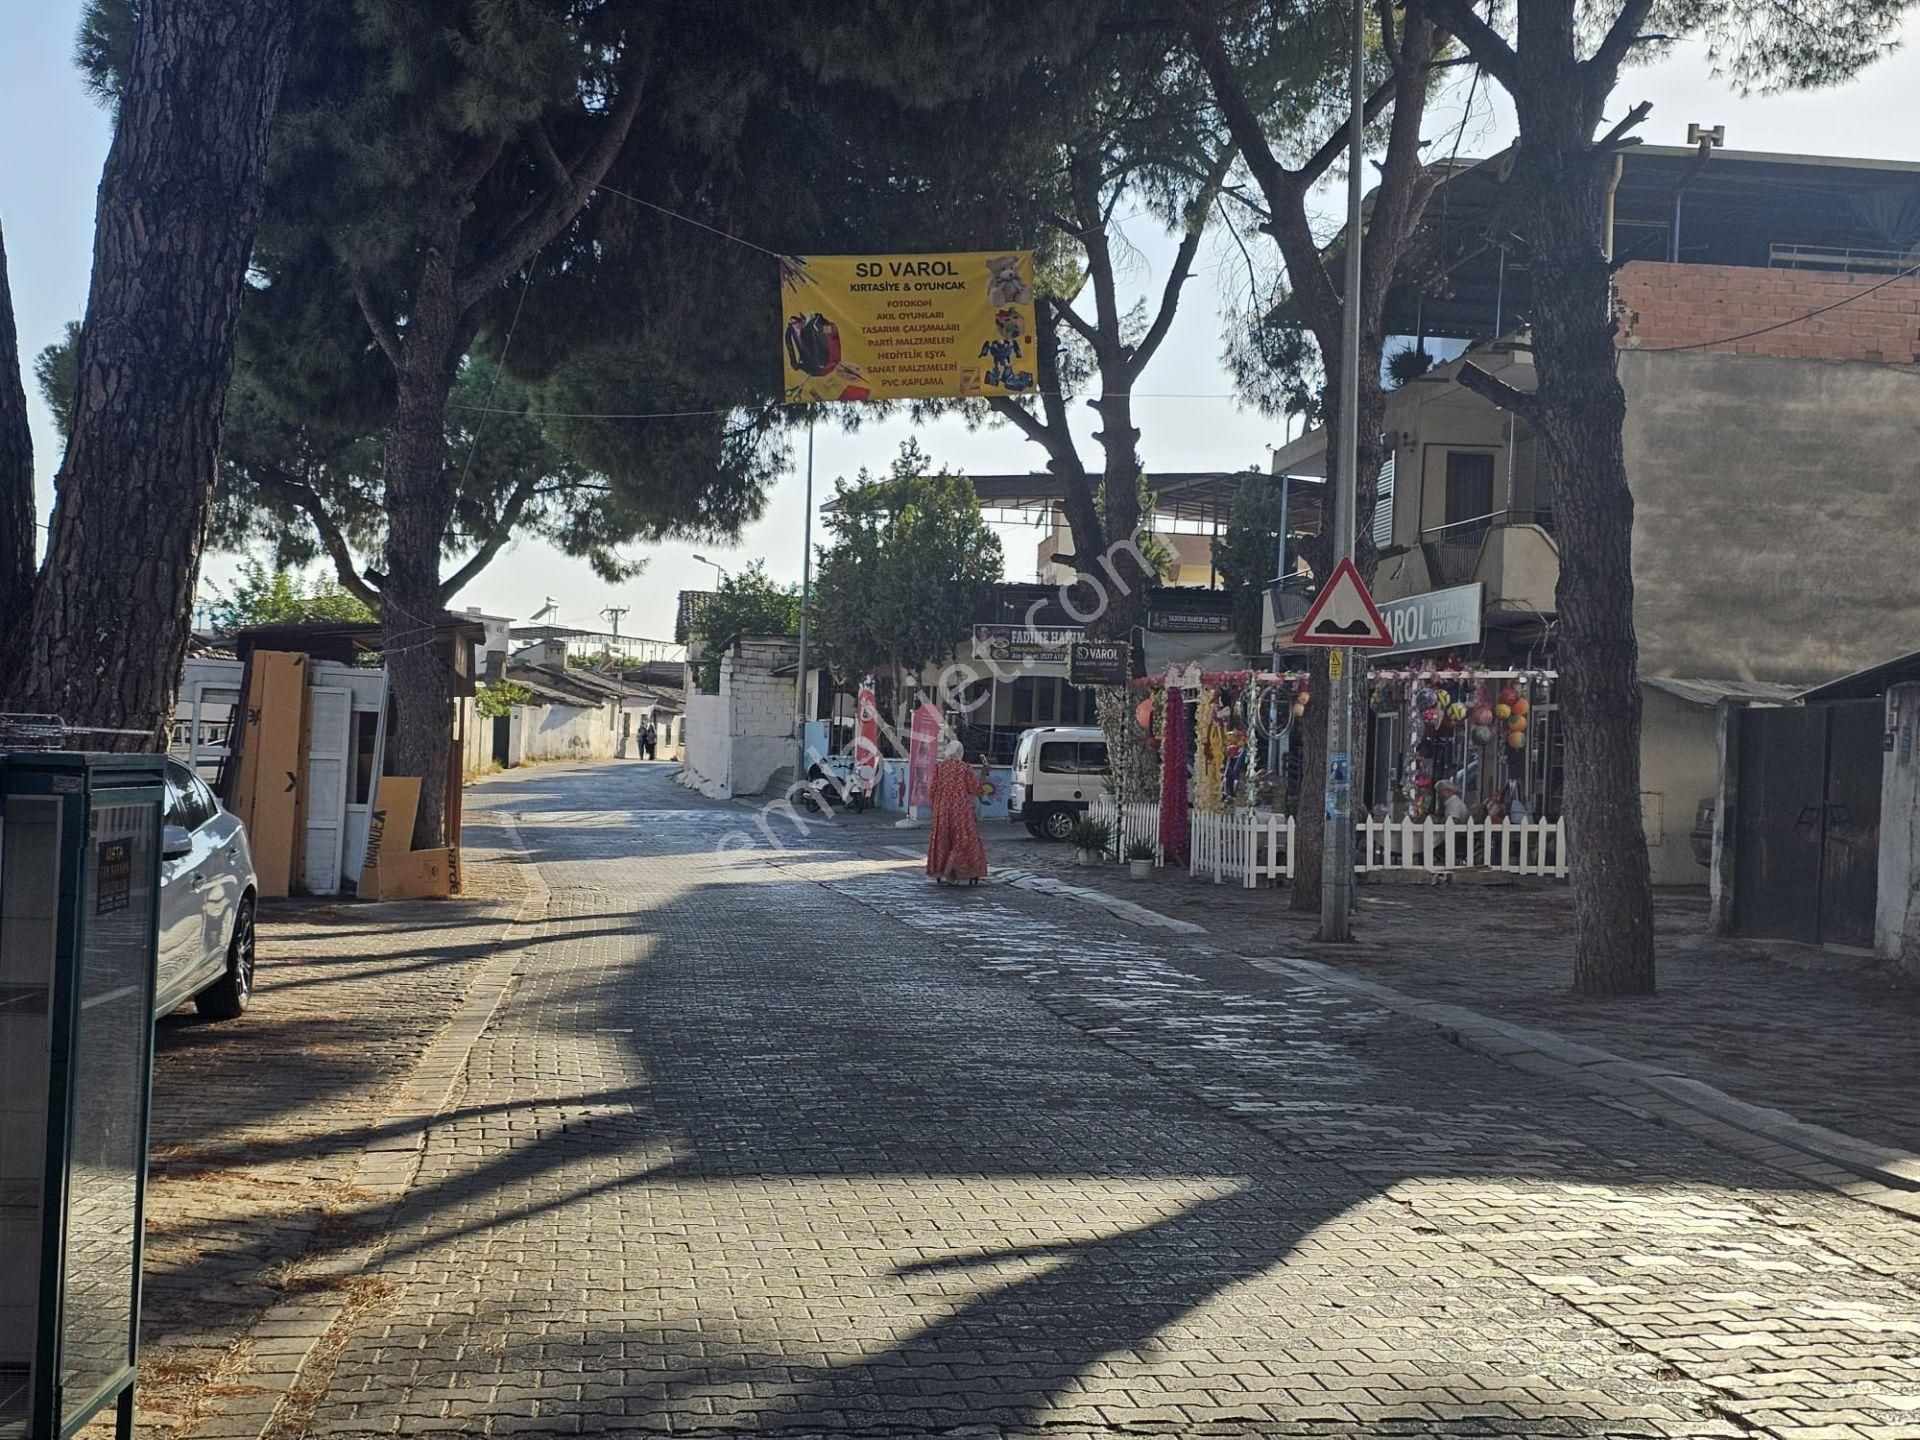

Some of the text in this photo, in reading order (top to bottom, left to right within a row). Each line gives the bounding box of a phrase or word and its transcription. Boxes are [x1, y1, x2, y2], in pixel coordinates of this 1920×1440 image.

[856, 261, 959, 277] SD VAROL
[850, 281, 966, 292] KIRTASİYE & OYUNCAK
[887, 299, 932, 308] FOTOKOPİ
[876, 311, 944, 321] AKIL OYUNLARI
[861, 324, 960, 335] TASARIM ÇALIŞMALARI
[867, 335, 954, 347] PARTİ MALZEMELERİ
[877, 349, 946, 360] HEDİYELİK EŞYA
[867, 362, 958, 374] SANAT MALZEMELERİ
[881, 378, 944, 387] PVC KAPLAMA
[1089, 647, 1120, 660] VAROL
